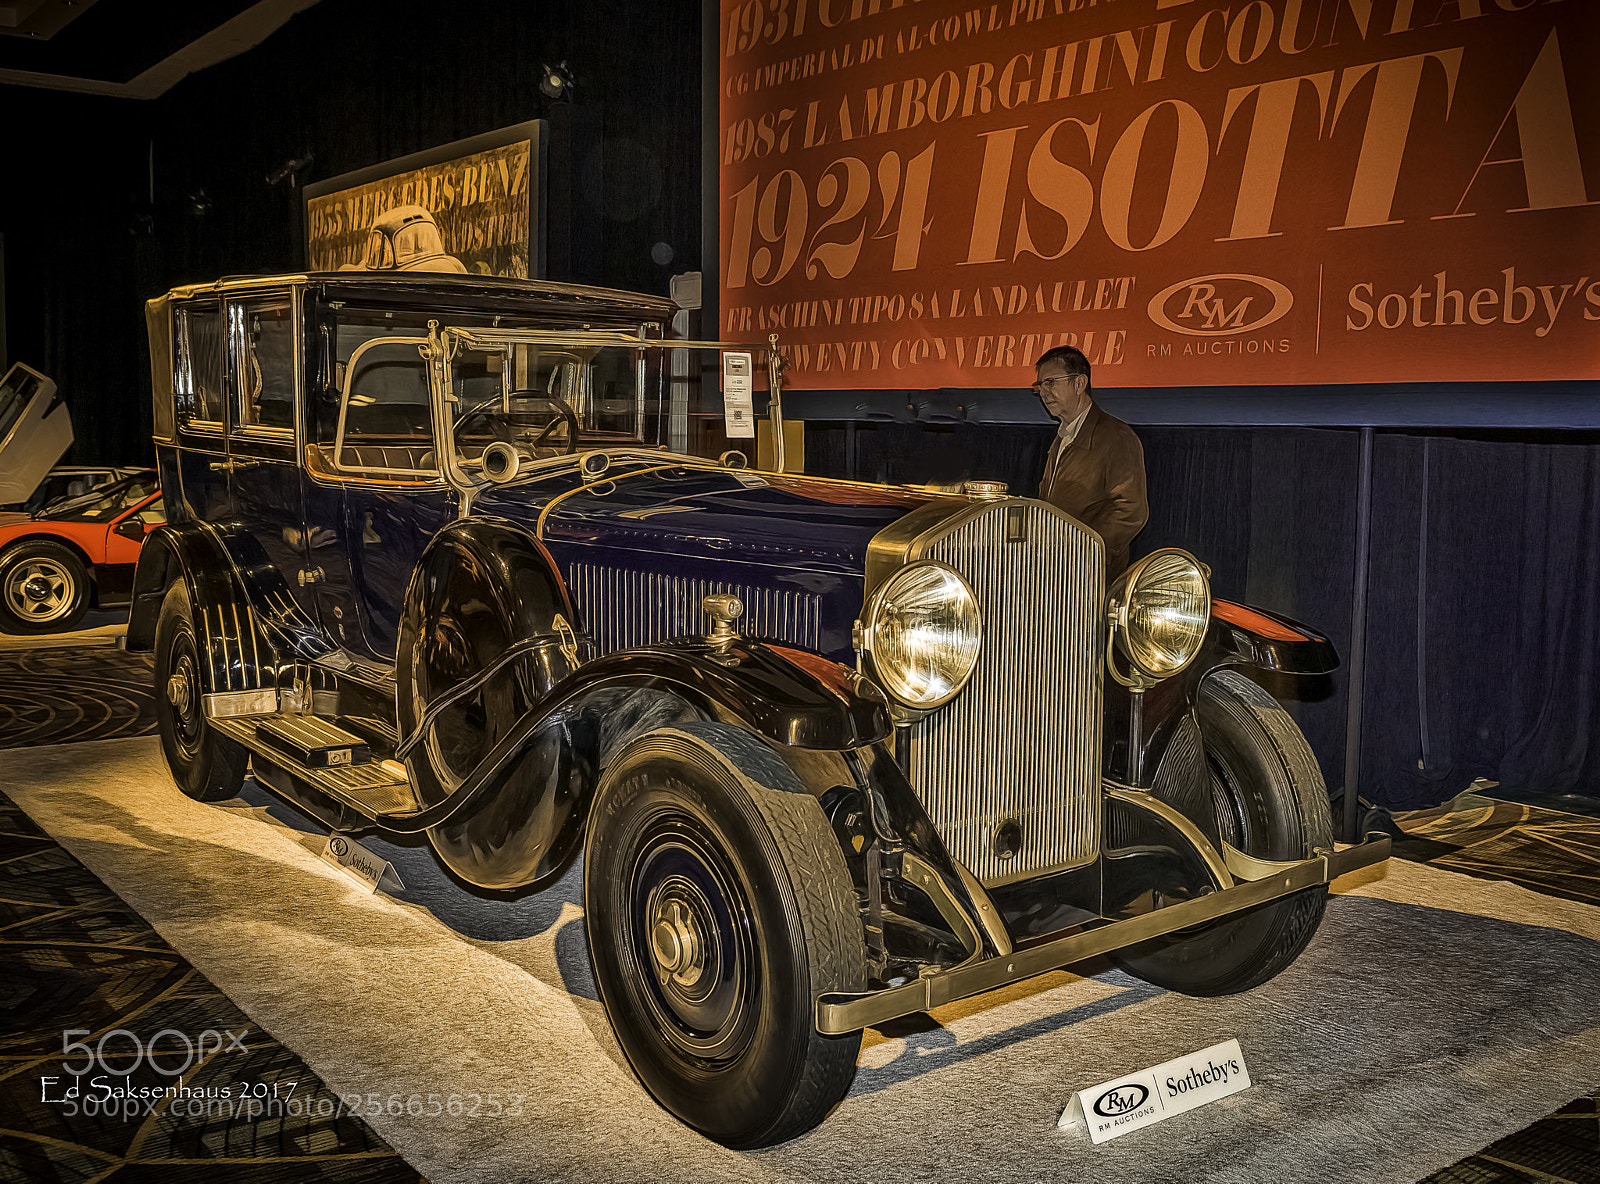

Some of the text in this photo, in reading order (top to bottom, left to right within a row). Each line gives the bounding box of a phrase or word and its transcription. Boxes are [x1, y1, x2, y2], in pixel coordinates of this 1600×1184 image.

[726, 0, 807, 57] 1931
[724, 0, 1565, 166] 1987 LAMBORGHINI COUNT
[726, 72, 749, 98] CG
[754, 44, 854, 91] IMPERIAL
[726, 26, 1600, 289] 1924 ISOTTA
[726, 298, 844, 333] FRASCHINI
[849, 294, 906, 324] TIPO
[946, 276, 1136, 319] LANDAULET
[1177, 283, 1254, 329] RM
[1345, 266, 1600, 338] Sotheby's
[1147, 339, 1290, 357] RM AUCTIONS
[1107, 1091, 1135, 1112] RM
[1166, 1059, 1240, 1098] Sotheby's
[1098, 1106, 1155, 1132] RM AUCTIONS
